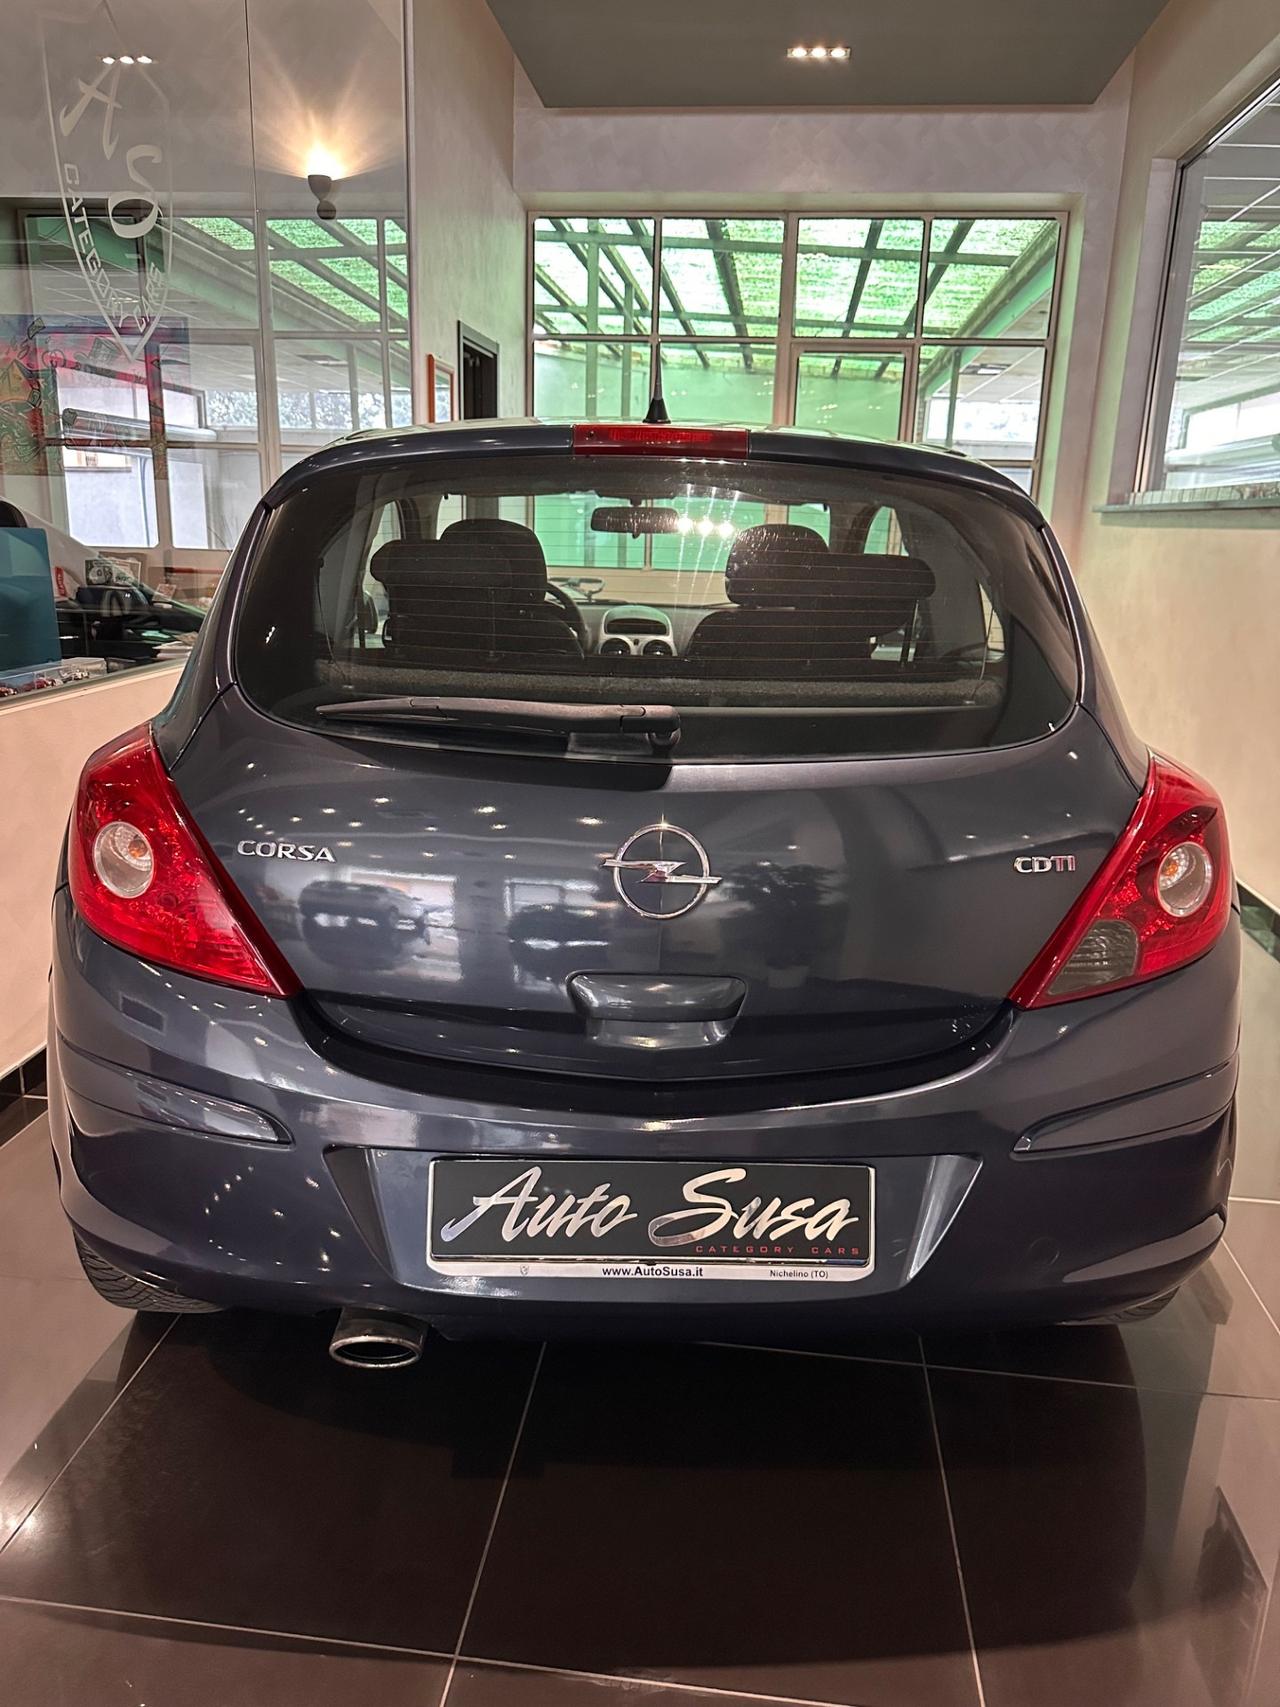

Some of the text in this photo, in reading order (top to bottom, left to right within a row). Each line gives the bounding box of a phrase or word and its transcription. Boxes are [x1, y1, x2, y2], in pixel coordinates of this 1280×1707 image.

[237, 840, 336, 863] CORSA
[1013, 855, 1076, 874] CDTI
[440, 1165, 859, 1248] Auto Susa
[695, 1245, 861, 1256] CATEGORY CARS
[602, 1265, 703, 1278] www.AutoSusa.it
[770, 1268, 829, 1280] Nichelino (TO)
